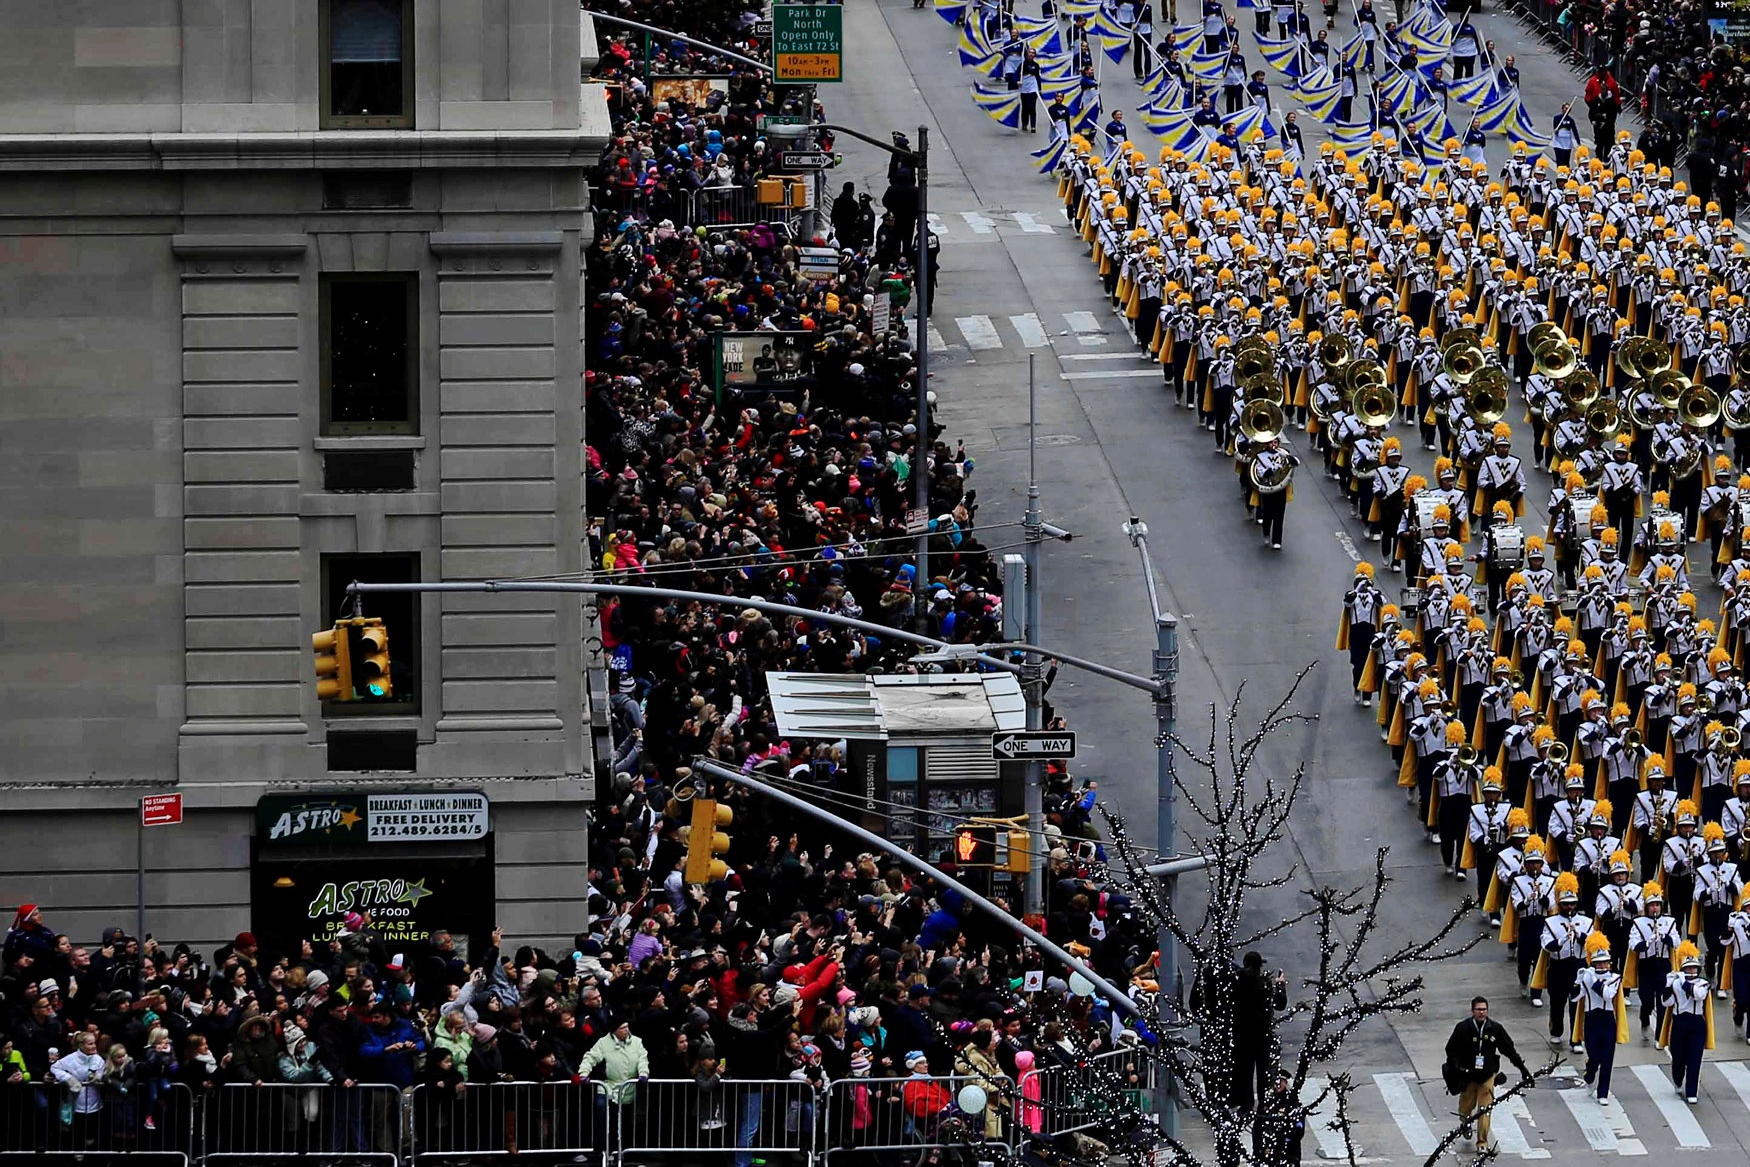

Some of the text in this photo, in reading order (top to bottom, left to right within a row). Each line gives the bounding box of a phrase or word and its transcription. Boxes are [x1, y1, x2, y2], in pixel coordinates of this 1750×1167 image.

[788, 9, 826, 17] Park Dr
[794, 19, 822, 29] North
[781, 31, 834, 41] Open Only
[776, 42, 840, 51] To East 72 St
[782, 67, 801, 76] Mon
[822, 67, 836, 76] Fri
[724, 342, 744, 352] NEW
[722, 352, 744, 363] YORK
[1003, 740, 1068, 751] ONE WAY
[866, 754, 876, 810] Newsstand
[369, 798, 482, 811] BREAKFAST LUNCH DINNER
[270, 808, 342, 839] ASTRO
[376, 814, 475, 825] FREE DELIVERY
[370, 825, 482, 836] 212.489.6284/5
[308, 878, 404, 918] ASTRO
[380, 908, 410, 916] FOOD
[326, 921, 416, 931] BRKFAST
[384, 932, 430, 941] INNER
